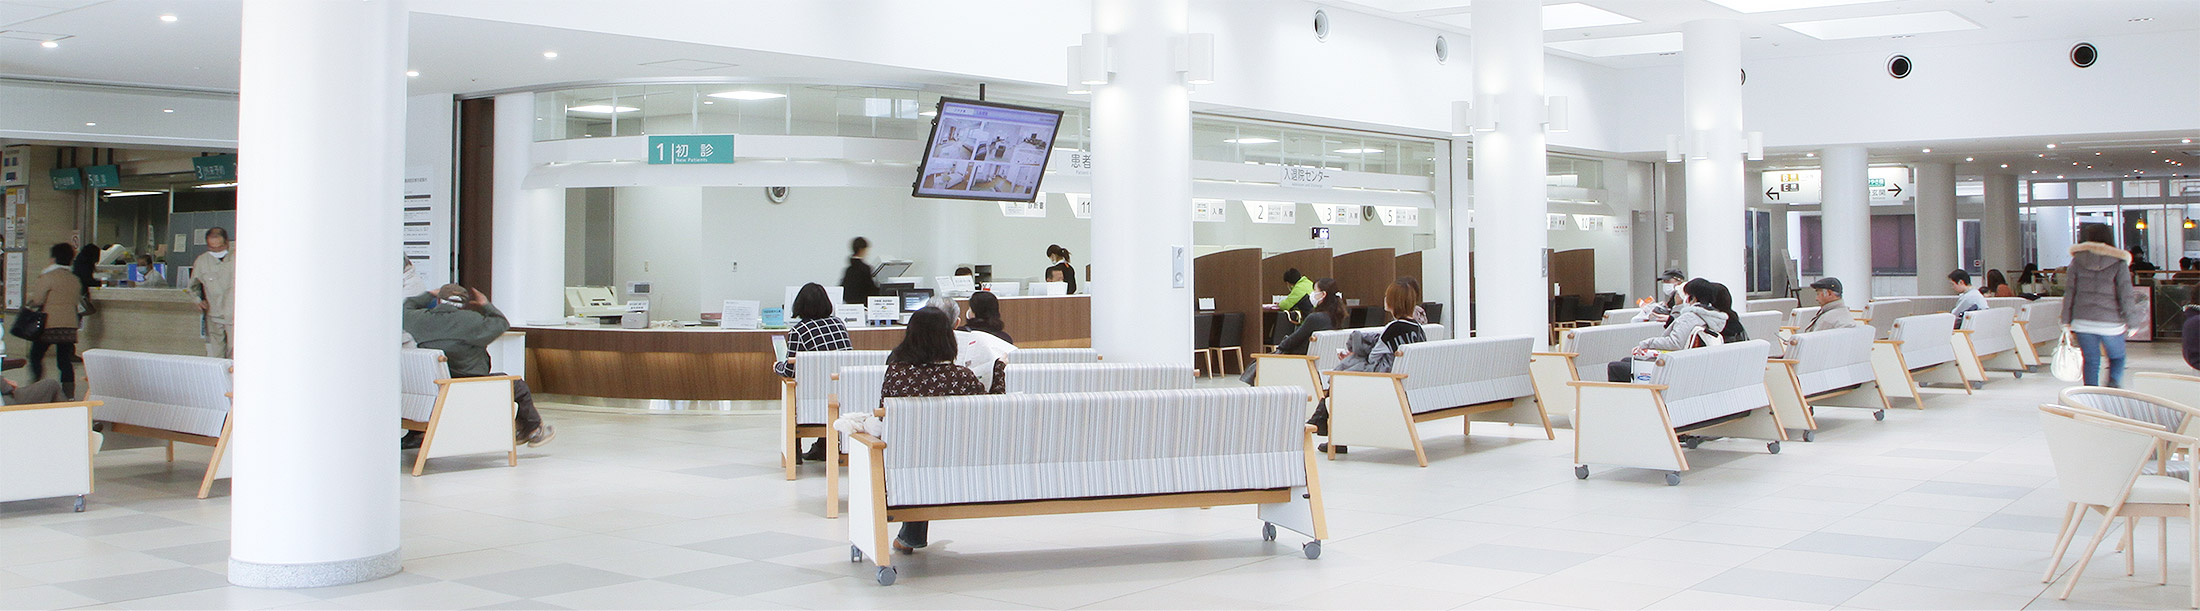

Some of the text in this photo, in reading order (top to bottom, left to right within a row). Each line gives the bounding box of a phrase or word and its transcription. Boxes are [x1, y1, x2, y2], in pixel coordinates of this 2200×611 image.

[656, 142, 664, 161] 1
[1284, 167, 1330, 182] 入退院センター
